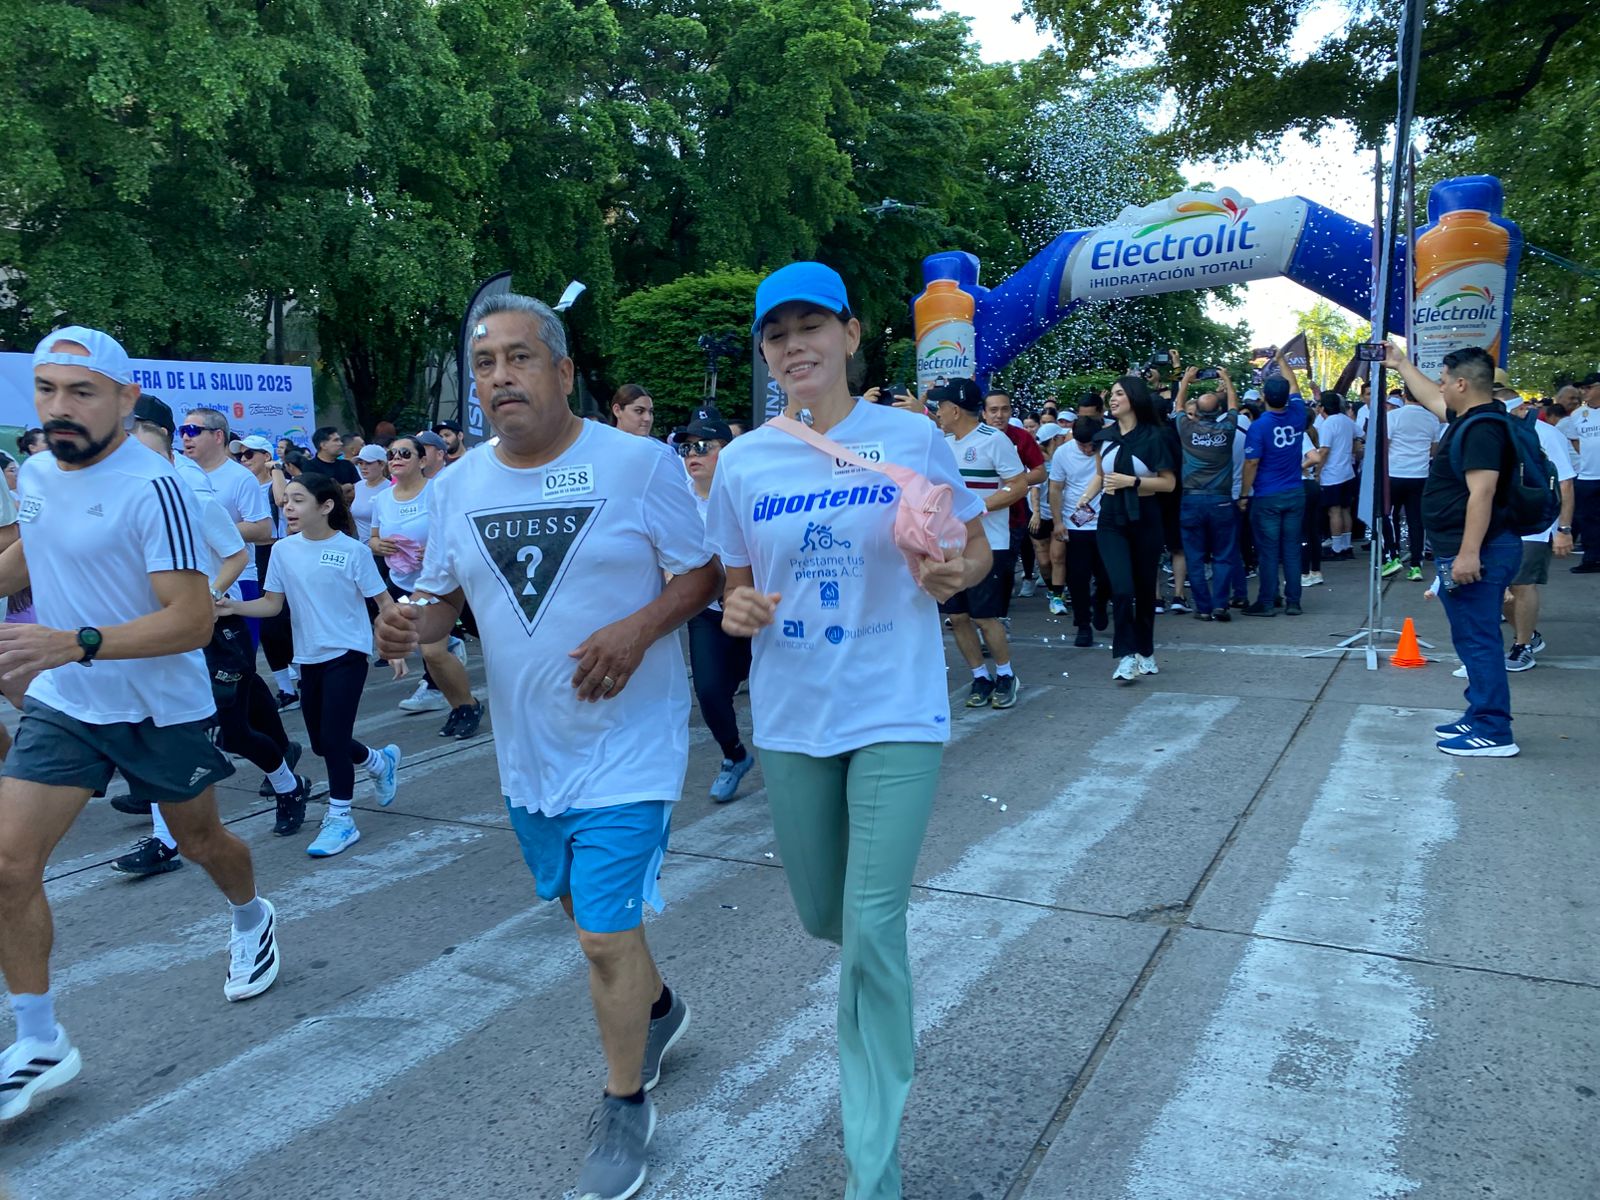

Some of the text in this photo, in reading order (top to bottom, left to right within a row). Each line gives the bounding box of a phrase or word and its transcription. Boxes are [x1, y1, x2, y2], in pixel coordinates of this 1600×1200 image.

[1091, 221, 1255, 270] Electrolit
[1089, 258, 1253, 289] ¡HIDRATACIÓN TOTAL!
[1416, 304, 1497, 323] Electrolit
[131, 370, 292, 392] ERA DE LA SALUD 2025
[546, 471, 588, 489] 0258
[753, 484, 896, 523] dportenis
[484, 515, 577, 540] GUESS
[322, 553, 345, 564] 0442
[789, 555, 865, 568] Préstame tus
[795, 564, 863, 582] piernas A.C.
[844, 621, 893, 640] publicidad
